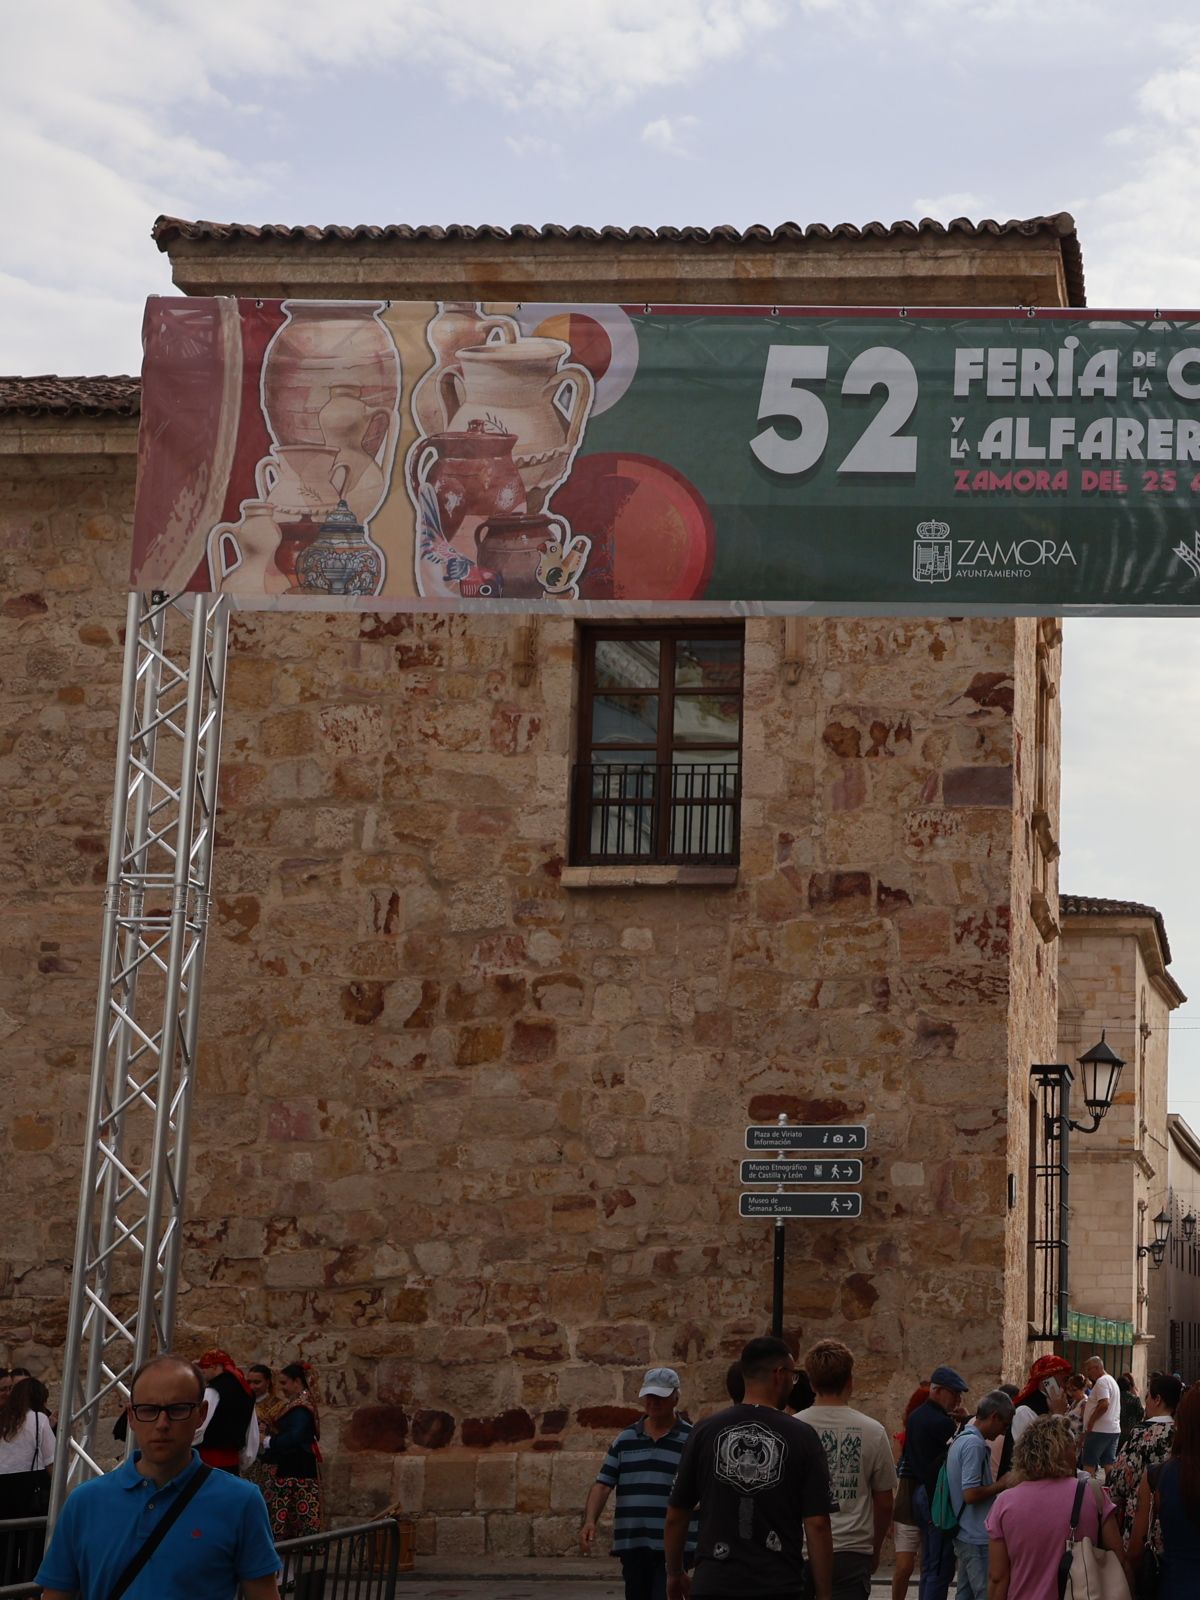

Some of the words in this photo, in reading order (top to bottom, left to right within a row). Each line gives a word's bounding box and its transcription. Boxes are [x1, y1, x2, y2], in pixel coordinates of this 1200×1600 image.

[1133, 352, 1156, 367] DE
[1133, 377, 1152, 397] LA
[750, 345, 919, 475] 52
[951, 417, 965, 432] Y
[950, 438, 970, 458] LA
[954, 469, 1069, 491] ZAMORA
[1081, 470, 1128, 491] DEL
[1142, 470, 1177, 492] 25
[957, 539, 1077, 566] ZAMORA
[956, 569, 1032, 578] AYUNTAMIENTO
[754, 1130, 770, 1138] Plaza
[772, 1130, 779, 1138] de
[781, 1130, 803, 1138] Viriato
[753, 1138, 792, 1146] Información
[749, 1163, 770, 1171] Museo
[771, 1163, 808, 1172] Etnográfico
[758, 1171, 781, 1179] Castilla
[788, 1171, 803, 1179] León
